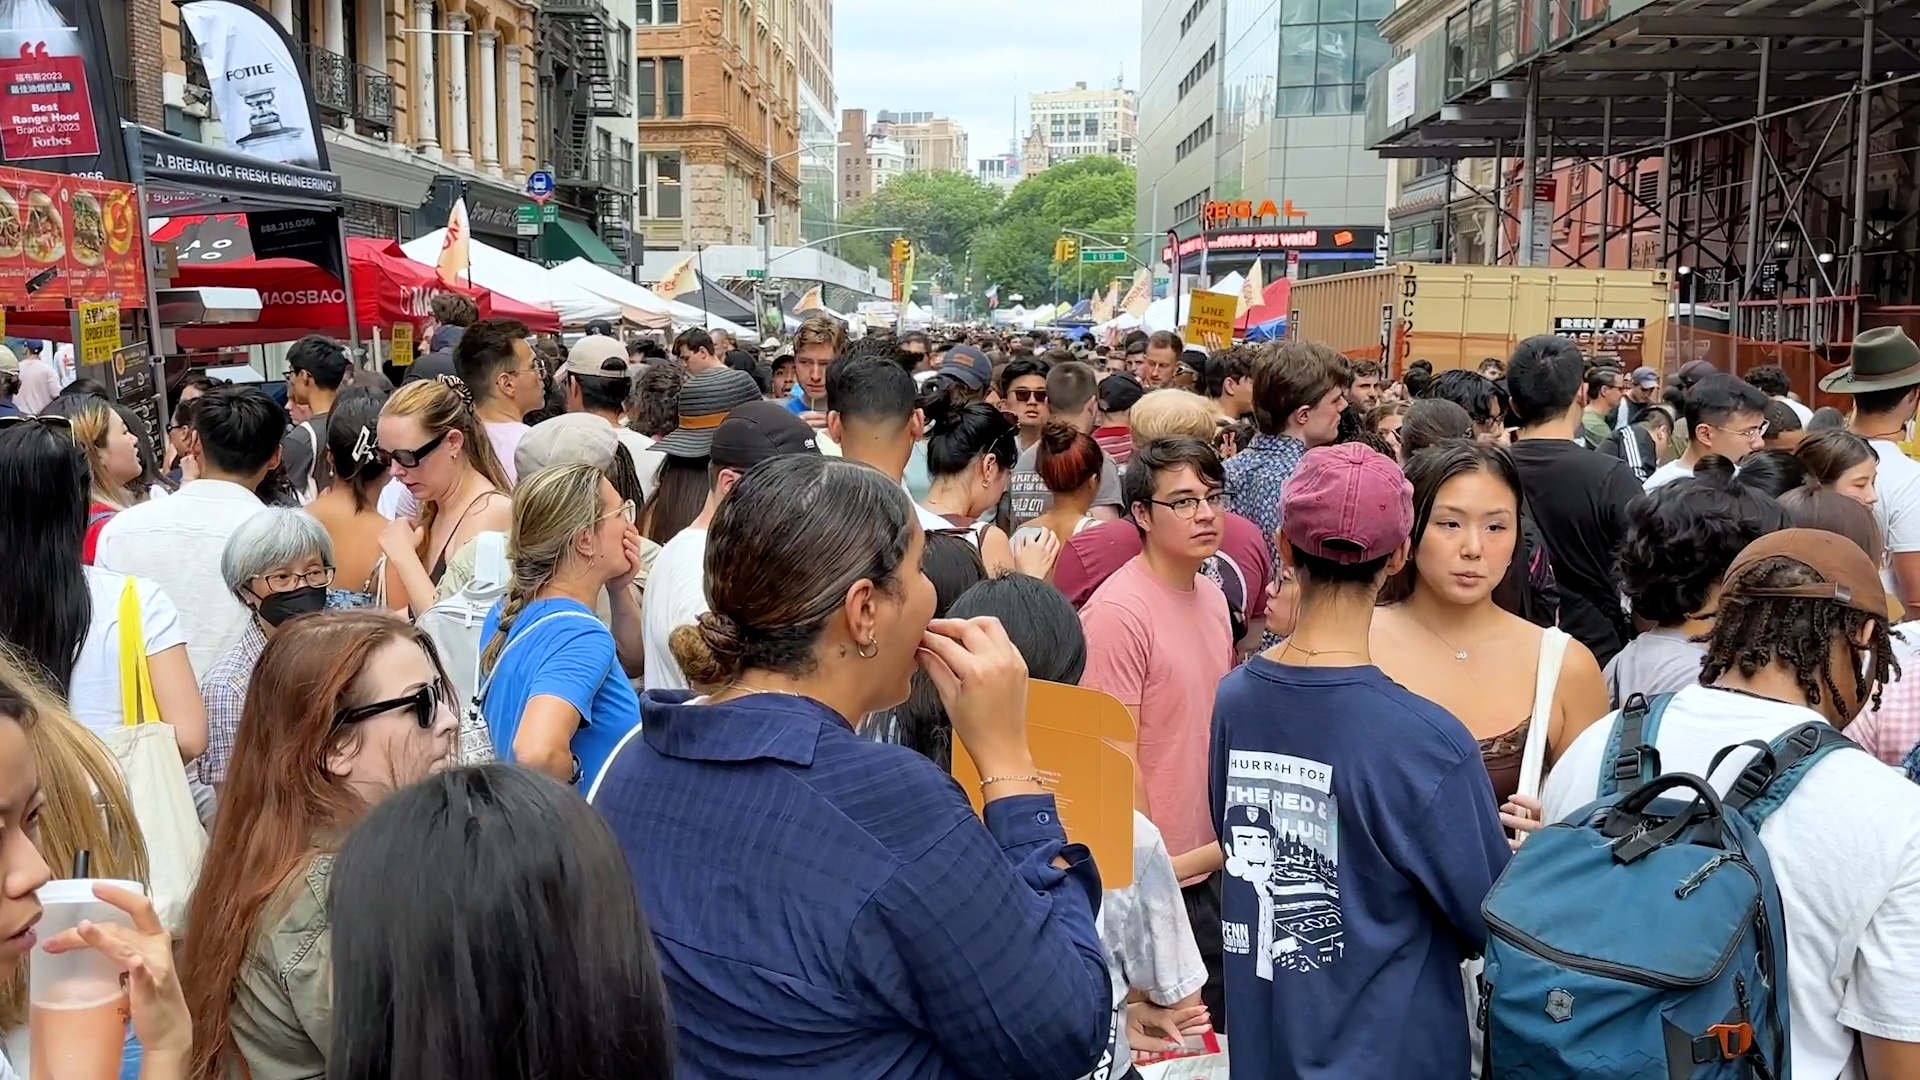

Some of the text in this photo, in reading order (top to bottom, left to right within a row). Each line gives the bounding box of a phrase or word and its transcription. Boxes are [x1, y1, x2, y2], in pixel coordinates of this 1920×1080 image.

[226, 63, 275, 81] FOTILE
[31, 103, 58, 113] Best
[12, 112, 80, 125] Range Hood
[16, 122, 80, 135] Brand of 2023
[32, 136, 72, 148] Forbes
[155, 153, 165, 167] A
[168, 155, 215, 175] BREATH
[217, 165, 232, 178] OF
[235, 166, 271, 184] FRESH
[1204, 199, 1308, 220] REGAL
[1255, 233, 1277, 247] you
[1201, 305, 1225, 317] LINE
[1190, 316, 1230, 330] STARTS
[1560, 318, 1640, 329] RENT ME
[1231, 759, 1326, 783] HURRAH FOR
[1227, 785, 1270, 804] THE
[1273, 789, 1315, 813] RED
[1221, 920, 1249, 940] PENN
